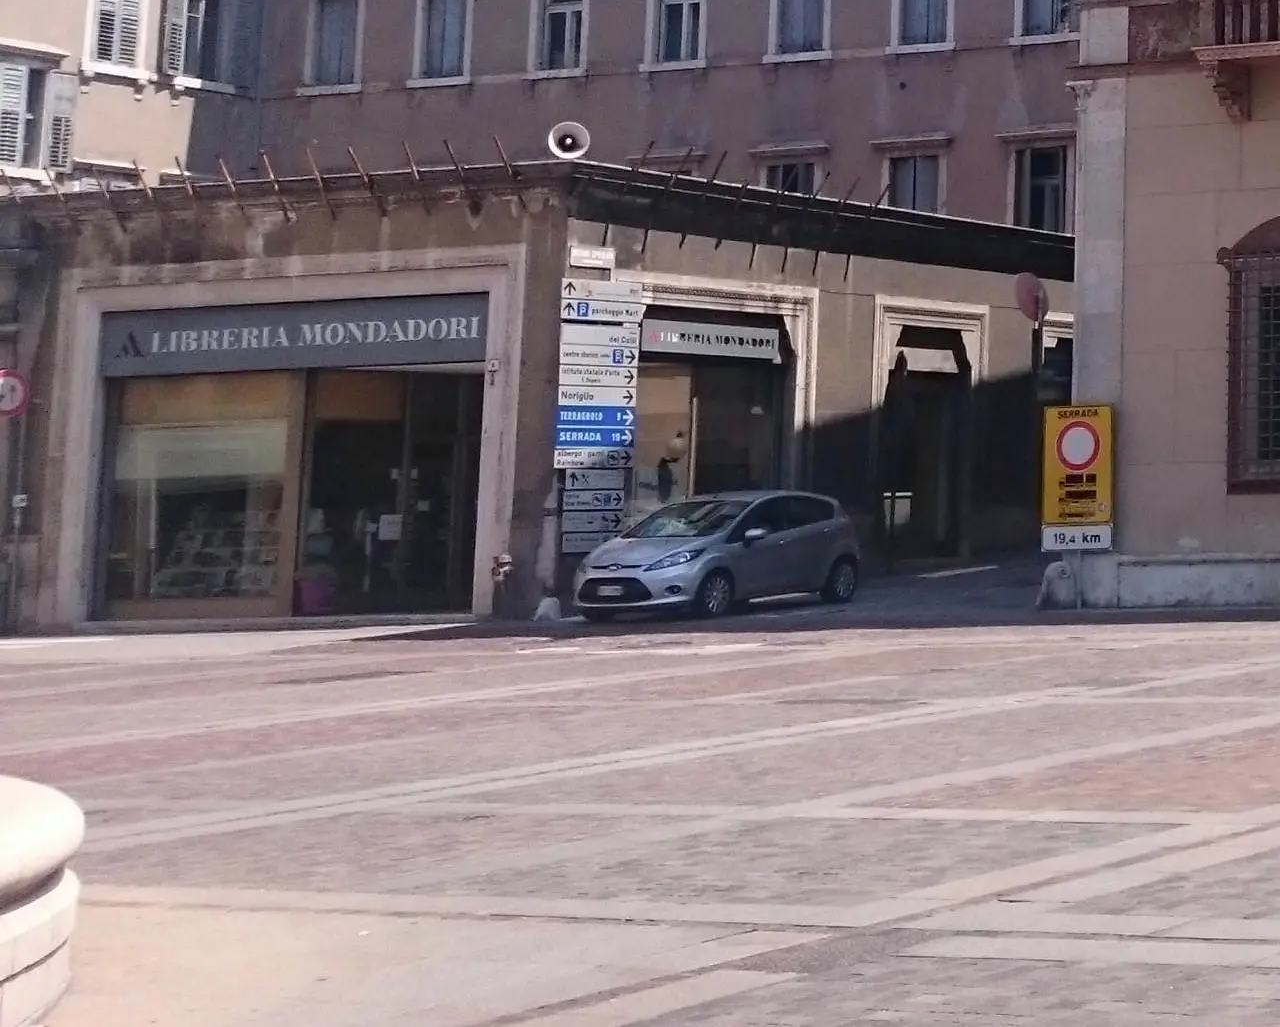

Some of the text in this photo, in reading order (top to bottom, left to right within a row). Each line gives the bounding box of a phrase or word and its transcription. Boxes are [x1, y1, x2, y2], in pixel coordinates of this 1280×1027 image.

[150, 315, 481, 354] LIBRERIA MONDADORI
[660, 331, 776, 349] LIBRERIA MONDADORI
[1057, 408, 1100, 420] SERRADA
[559, 431, 602, 442] SERRADA
[1081, 532, 1101, 544] km
